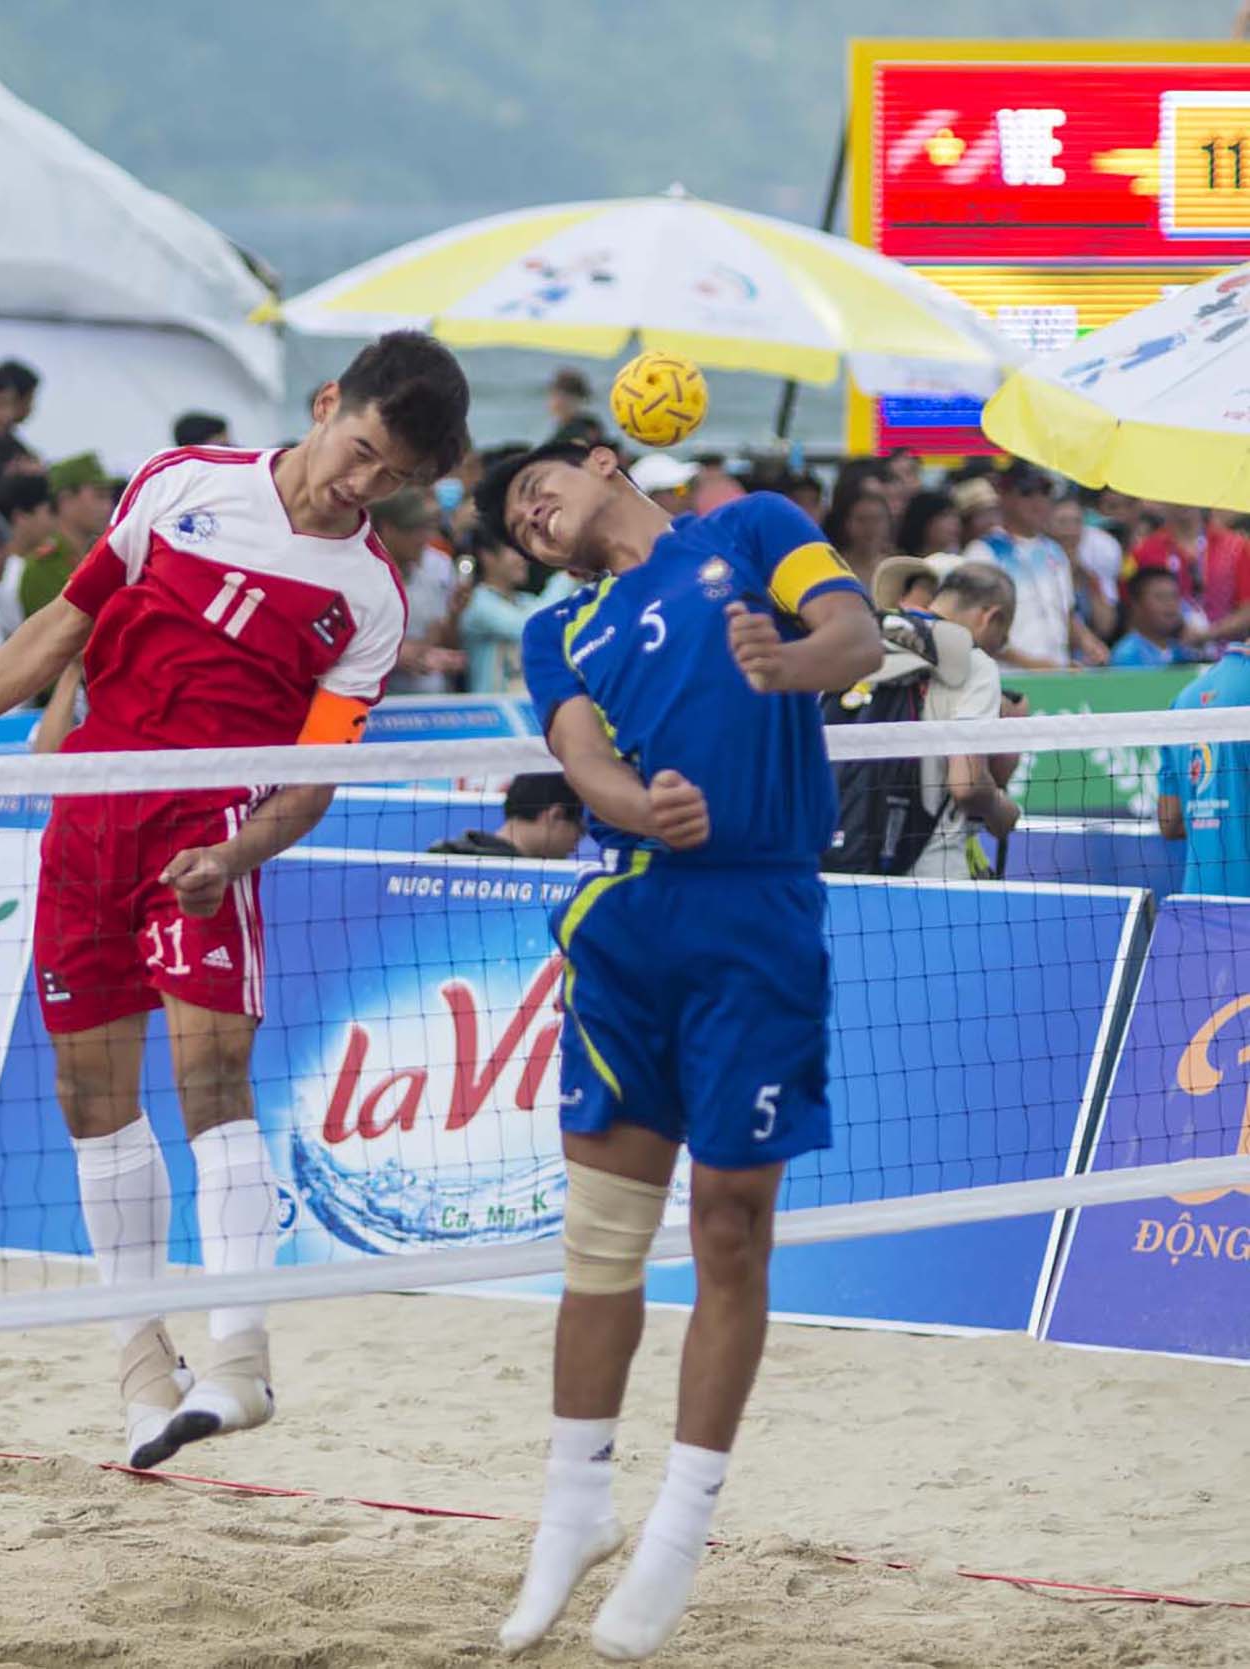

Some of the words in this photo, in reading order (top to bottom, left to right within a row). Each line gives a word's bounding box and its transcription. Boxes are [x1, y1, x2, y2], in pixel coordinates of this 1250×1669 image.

[202, 571, 266, 640] 11
[639, 599, 667, 652] 5
[146, 918, 191, 975] 11
[753, 1083, 782, 1139] 5
